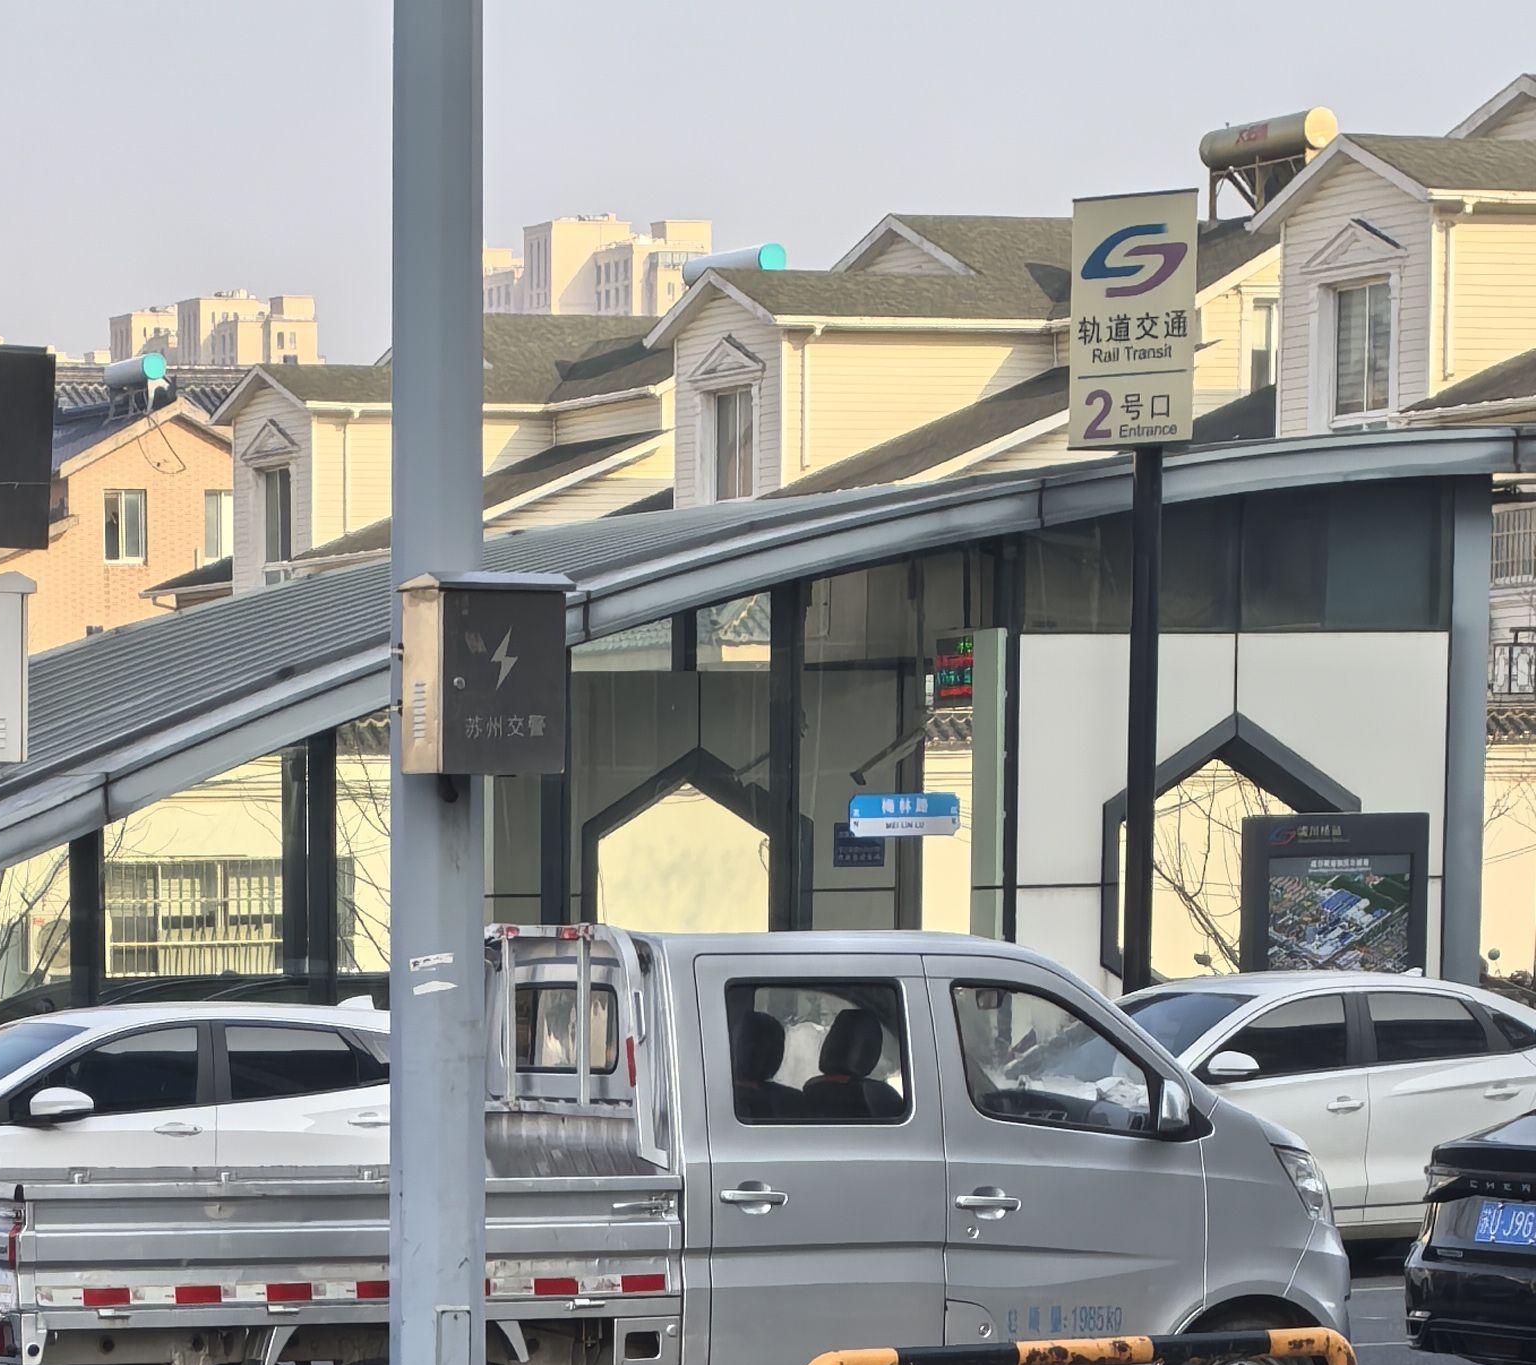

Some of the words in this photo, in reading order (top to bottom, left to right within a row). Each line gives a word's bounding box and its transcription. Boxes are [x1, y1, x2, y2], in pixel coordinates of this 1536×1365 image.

[1077, 309, 1188, 346] 轨道交通
[1092, 347, 1119, 363] Rail
[1124, 343, 1172, 361] Transit
[1119, 423, 1177, 438] Entrance
[465, 715, 546, 739] 苏州交警
